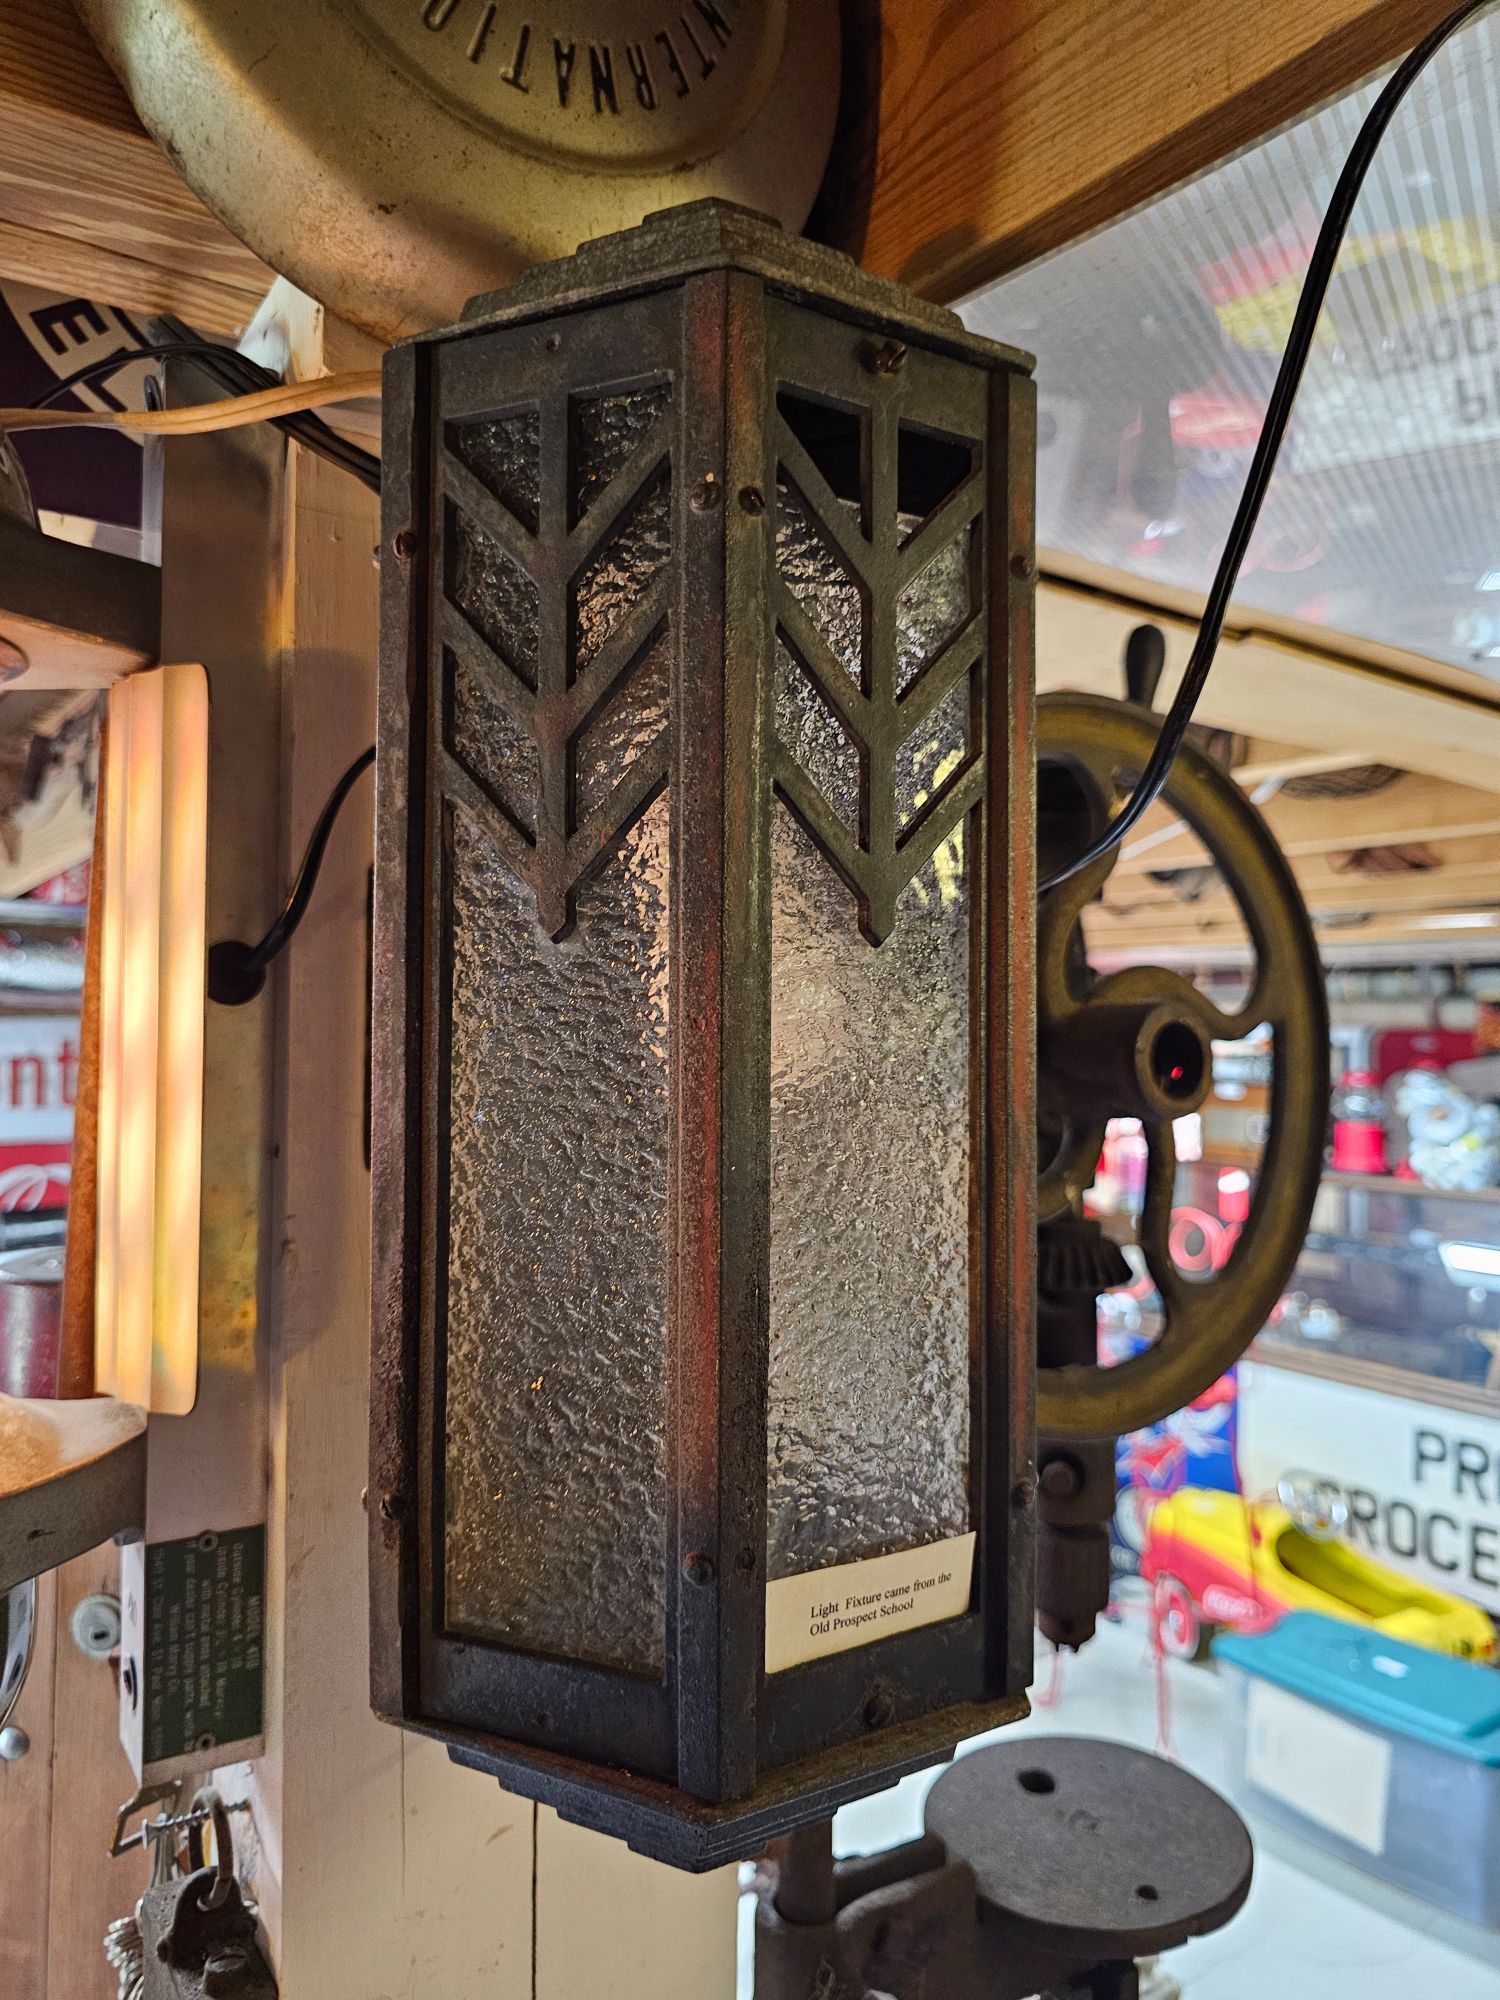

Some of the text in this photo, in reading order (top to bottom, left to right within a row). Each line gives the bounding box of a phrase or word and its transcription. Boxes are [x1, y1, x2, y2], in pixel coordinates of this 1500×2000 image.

[1413, 1430, 1500, 1506] PR
[809, 1598, 914, 1637] Old Prospect School
[811, 1571, 952, 1619] Light Fixture came from the
